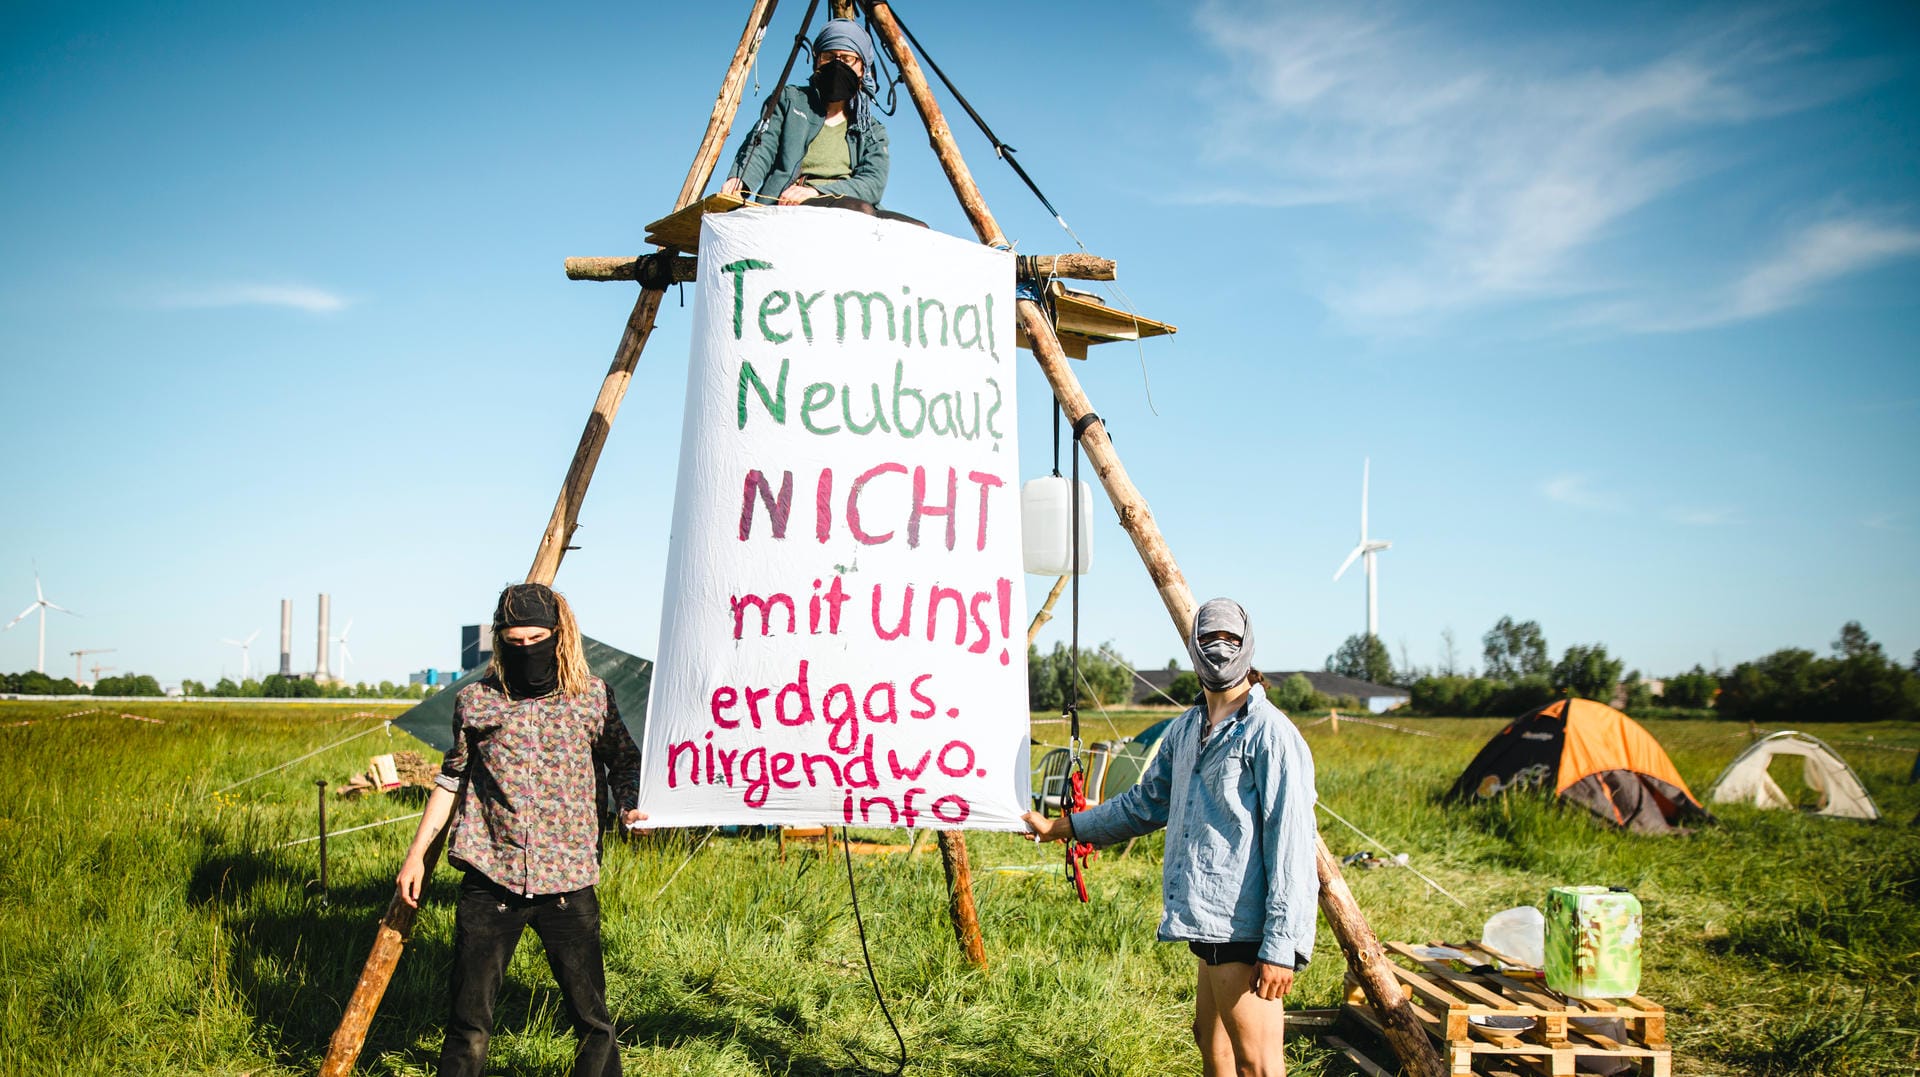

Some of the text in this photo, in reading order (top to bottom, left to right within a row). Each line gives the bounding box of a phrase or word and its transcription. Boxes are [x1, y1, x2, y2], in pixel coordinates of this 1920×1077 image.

[720, 258, 1000, 364] Terminal
[736, 357, 1003, 453] Neubau?
[736, 461, 1006, 551] NICHT
[729, 574, 1012, 666] mit uns!
[710, 659, 960, 755] erdgas.
[842, 787, 971, 829] info
